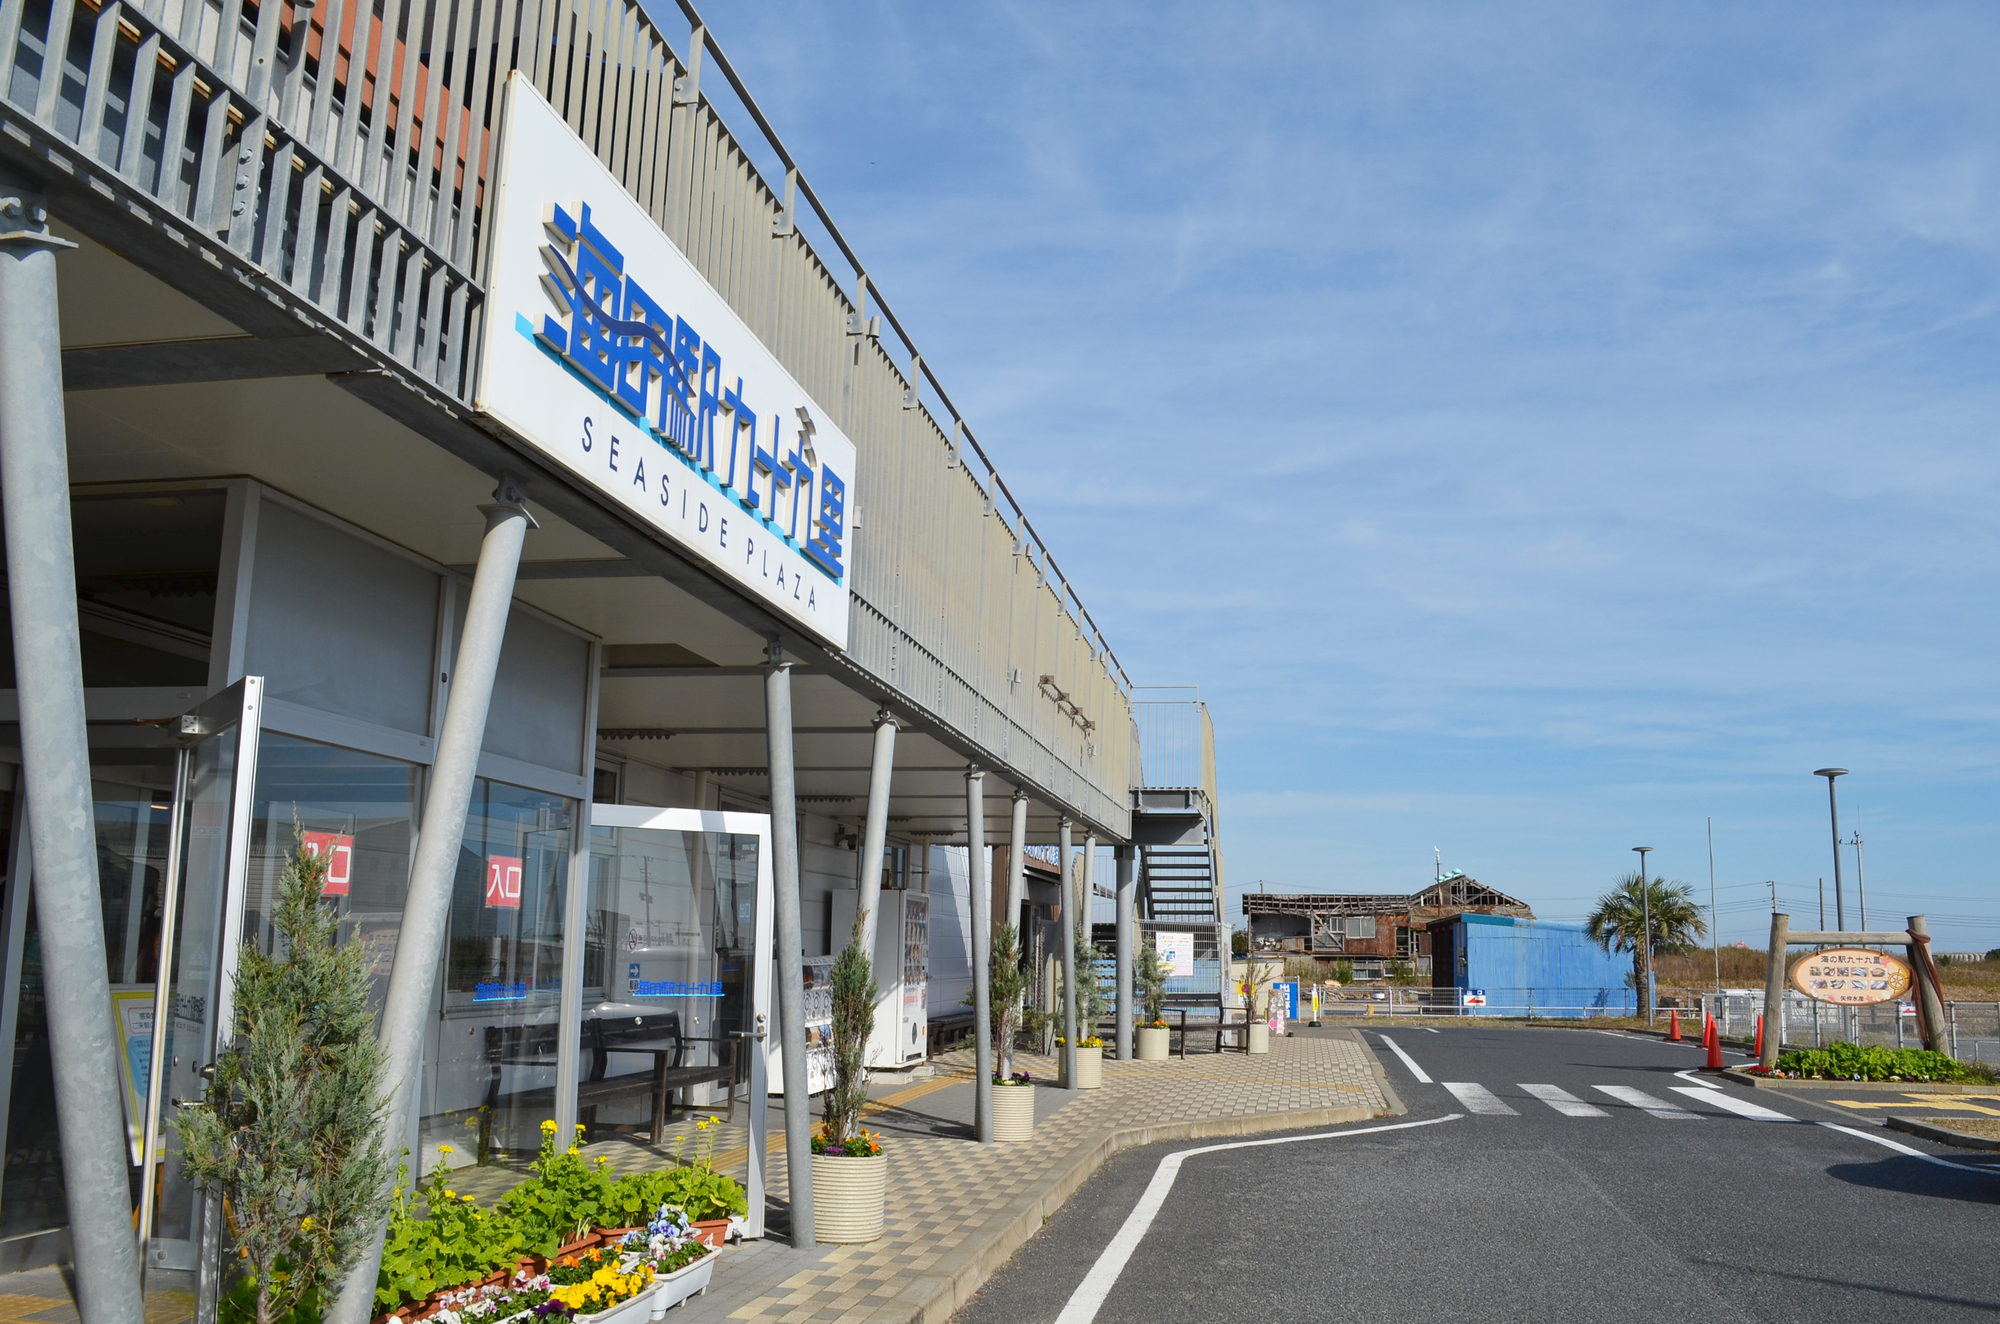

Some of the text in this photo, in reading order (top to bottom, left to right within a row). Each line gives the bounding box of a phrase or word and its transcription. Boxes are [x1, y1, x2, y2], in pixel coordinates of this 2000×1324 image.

[533, 200, 845, 578] 海の駅九十九里
[581, 415, 817, 612] SEASIDE PLAZA
[487, 863, 522, 899] 入口
[1820, 955, 1881, 964] 海の駅九十九里
[634, 979, 723, 995] 海の駅九十九里
